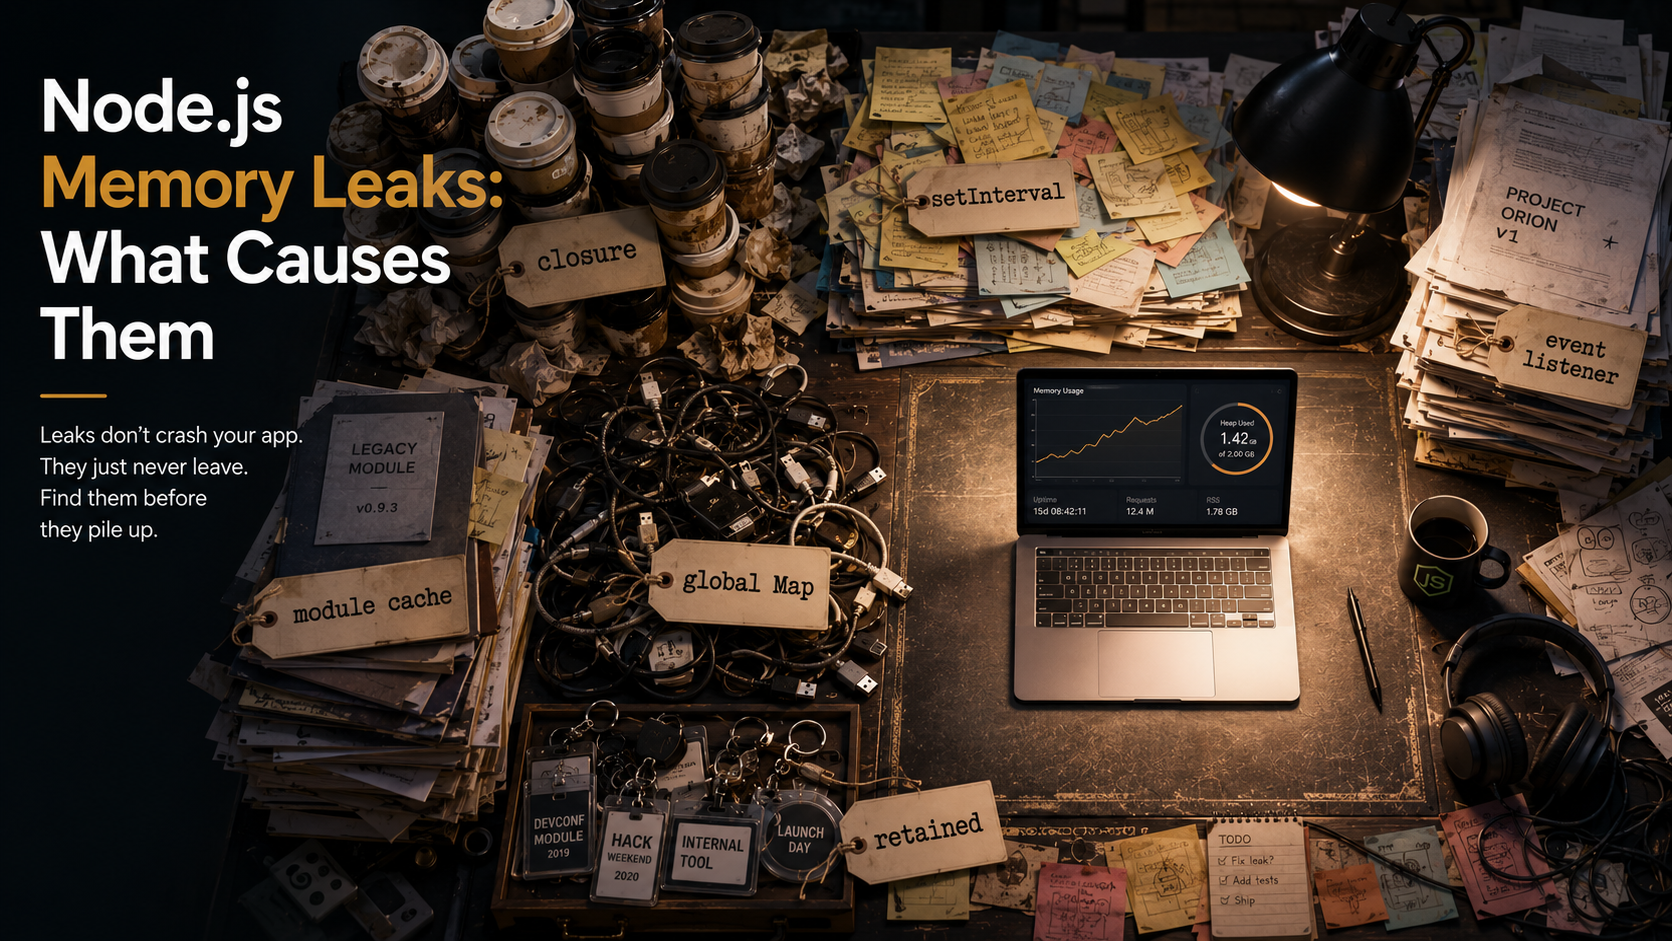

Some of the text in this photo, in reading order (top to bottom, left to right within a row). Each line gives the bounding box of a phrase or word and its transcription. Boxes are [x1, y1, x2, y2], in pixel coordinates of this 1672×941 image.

[931, 182, 1066, 208] setInterval
[1505, 186, 1586, 217] PROJECT
[1501, 206, 1558, 232] ORION
[1496, 226, 1519, 244] v1
[538, 244, 636, 271] closure
[1545, 334, 1607, 359] event
[1522, 349, 1620, 385] listener
[1033, 387, 1084, 396] Memory Usage
[1220, 419, 1255, 428] Heap Used
[1221, 431, 1249, 445] 1.42
[352, 443, 417, 455] LEGACY
[1218, 450, 1255, 458] of 2.00 GB
[349, 462, 415, 474] MODULE
[1033, 496, 1058, 504] Uptime
[1126, 496, 1157, 505] Requests
[1206, 496, 1221, 504] RSS
[357, 503, 397, 513] v0.9.3
[1034, 507, 1086, 516] 15d 08:42:11
[1126, 507, 1154, 516] 12.4 M
[1206, 507, 1238, 516] 1.78 GB
[683, 570, 813, 600] global Map
[1421, 573, 1446, 590] JS
[293, 588, 451, 623] module cache
[533, 814, 585, 831] DEVCONF
[777, 824, 825, 839] LAUNCH
[874, 812, 983, 849] retained
[534, 830, 584, 846] MODULE
[612, 833, 652, 849] HACK
[683, 836, 743, 852] INTERNAL
[1218, 834, 1252, 845] TODO
[548, 849, 569, 858] 2019
[788, 841, 812, 854] DAY
[608, 853, 651, 864] WEEKEND
[681, 855, 712, 869] TOOL
[1231, 855, 1274, 865] Fix leak?
[615, 871, 639, 881] 2020
[1232, 875, 1279, 886] Add tests
[1234, 895, 1256, 908] Ship
